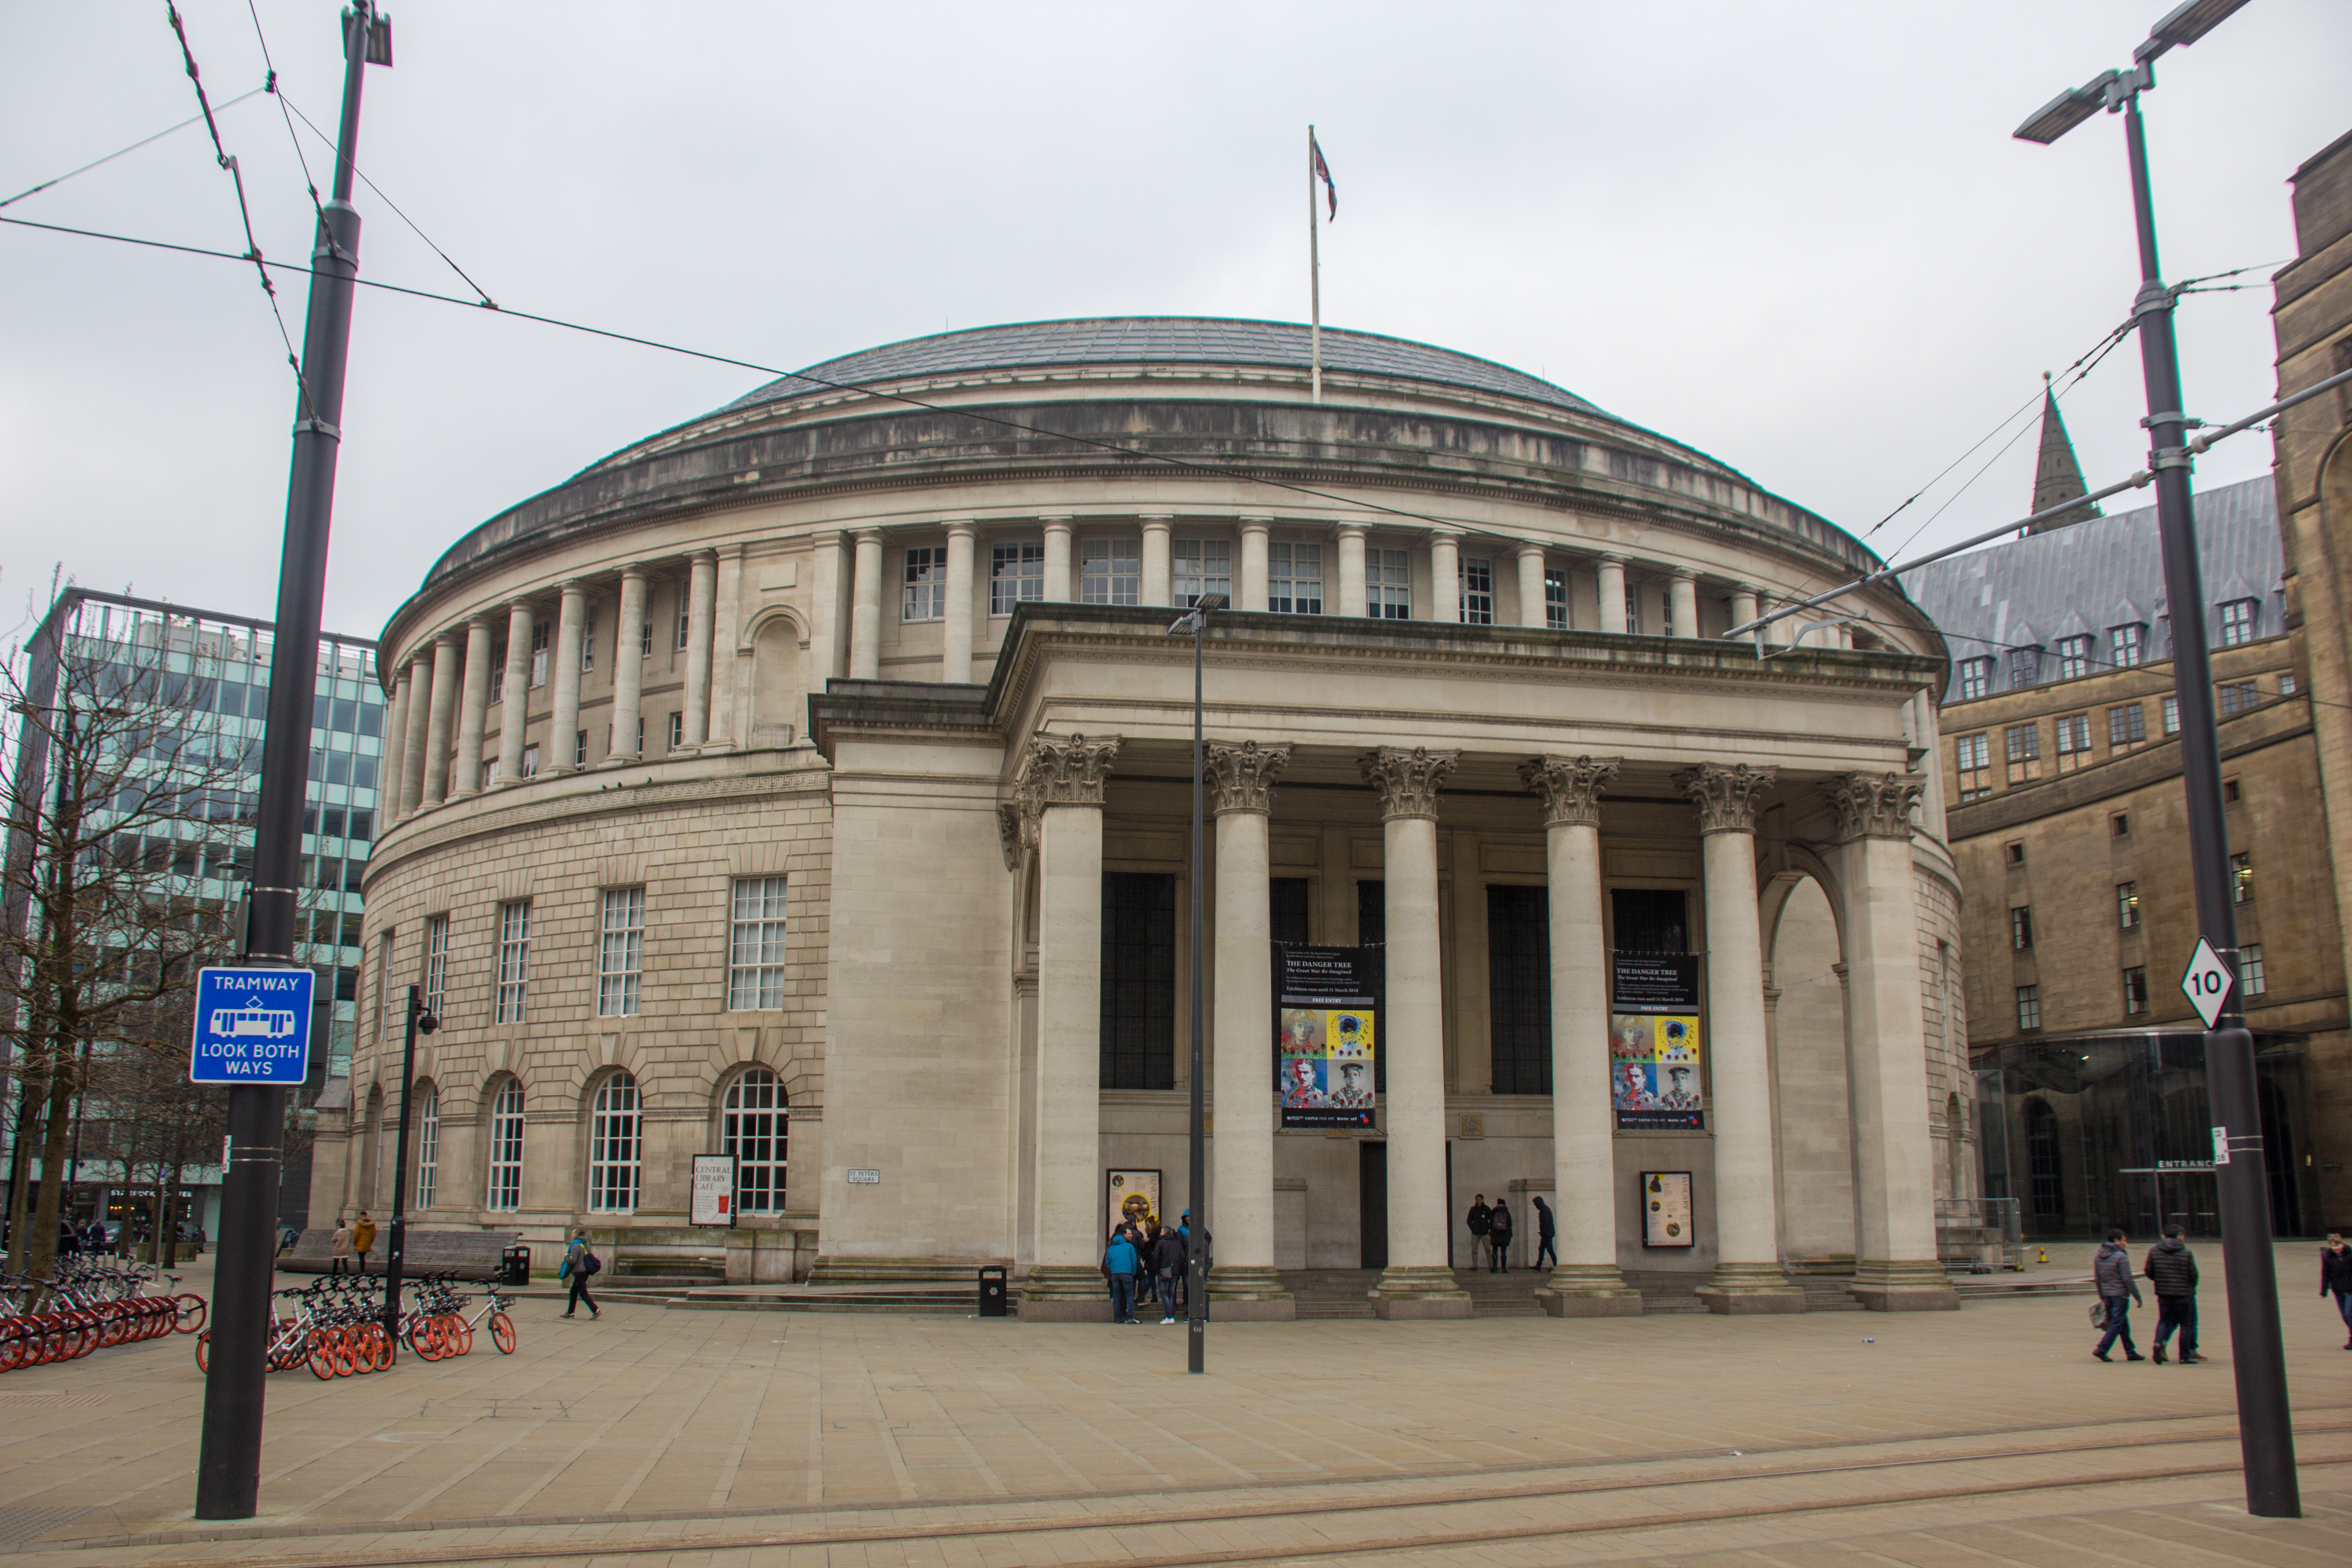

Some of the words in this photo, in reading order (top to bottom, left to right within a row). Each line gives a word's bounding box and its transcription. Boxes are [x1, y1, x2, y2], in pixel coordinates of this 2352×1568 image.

[214, 976, 299, 991] TRAMWAY
[2192, 970, 2221, 995] 10
[201, 1044, 248, 1057] LOOK
[253, 1044, 299, 1058] BOTH
[225, 1061, 273, 1075] WAYS
[695, 1181, 715, 1190] CAFÉ
